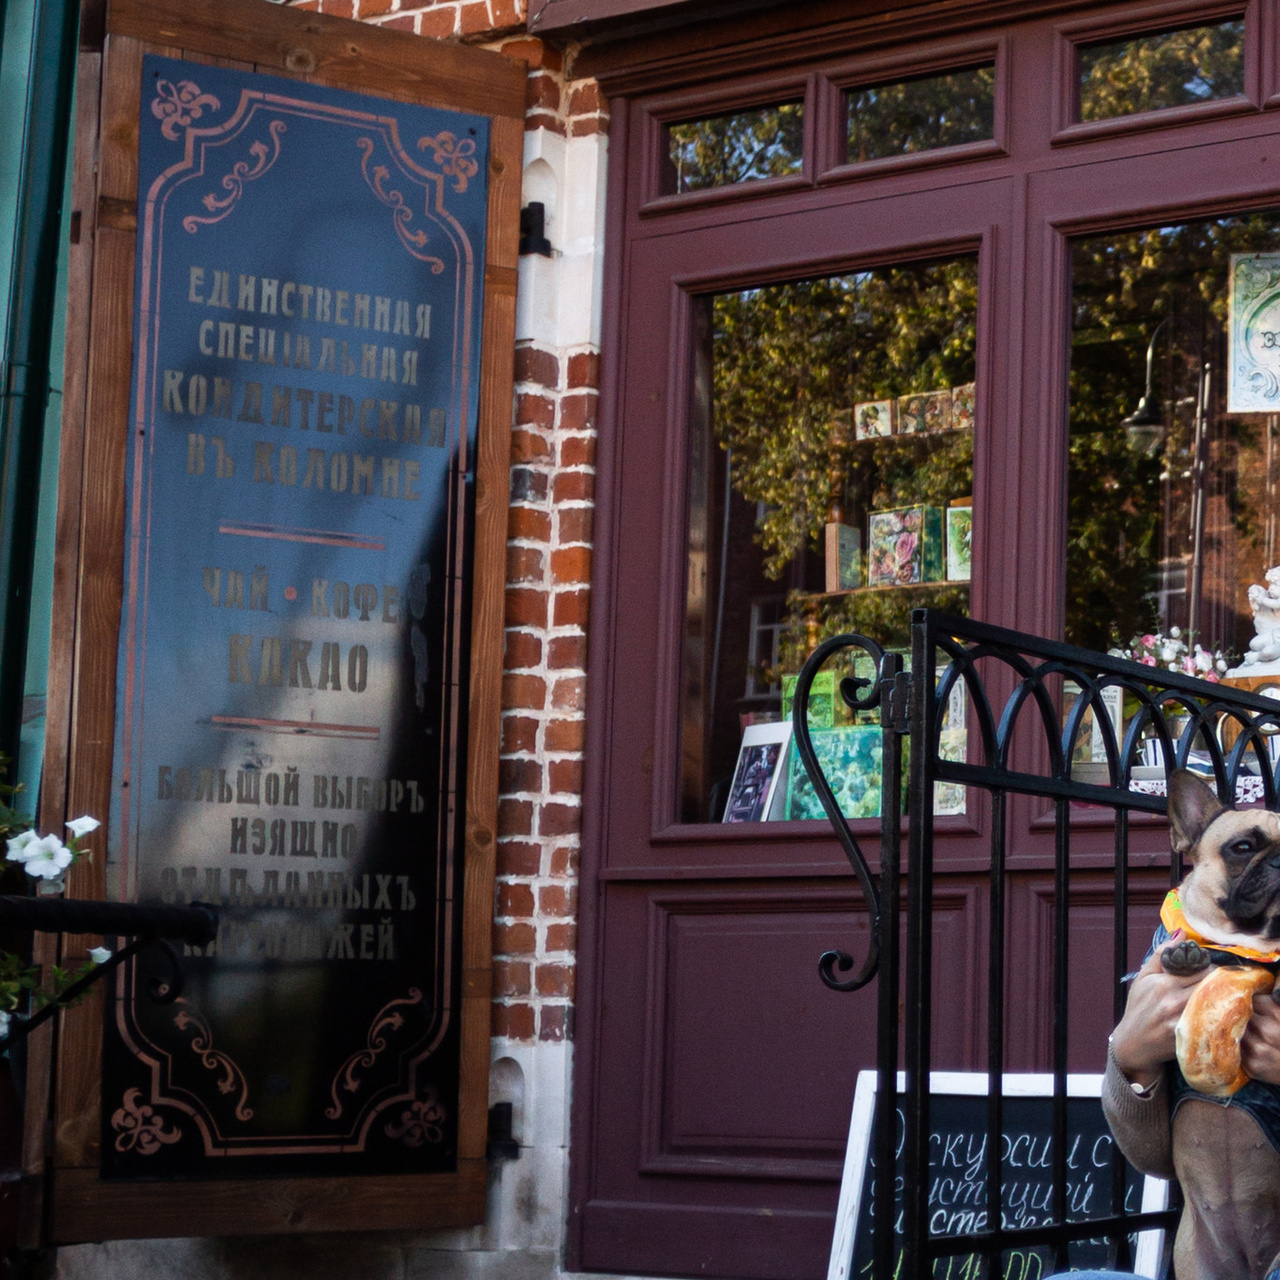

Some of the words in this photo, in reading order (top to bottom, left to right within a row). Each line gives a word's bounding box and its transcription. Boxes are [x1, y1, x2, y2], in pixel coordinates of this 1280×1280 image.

[188, 266, 432, 340] ЕДИНСТВЕННАЯ
[161, 368, 447, 449] КОНДИТЕРСКАЯ
[186, 432, 236, 479] ВЪ
[253, 440, 421, 502] КОЛОМНЕ
[201, 564, 270, 612] ЧАЙ
[310, 578, 400, 623] КОФЕ
[228, 633, 369, 694] КАКАО
[157, 765, 301, 807] БОЛЬШОЙ
[313, 774, 425, 813] ВЫБОРЪ
[230, 815, 358, 859] ИЗЯЩНО
